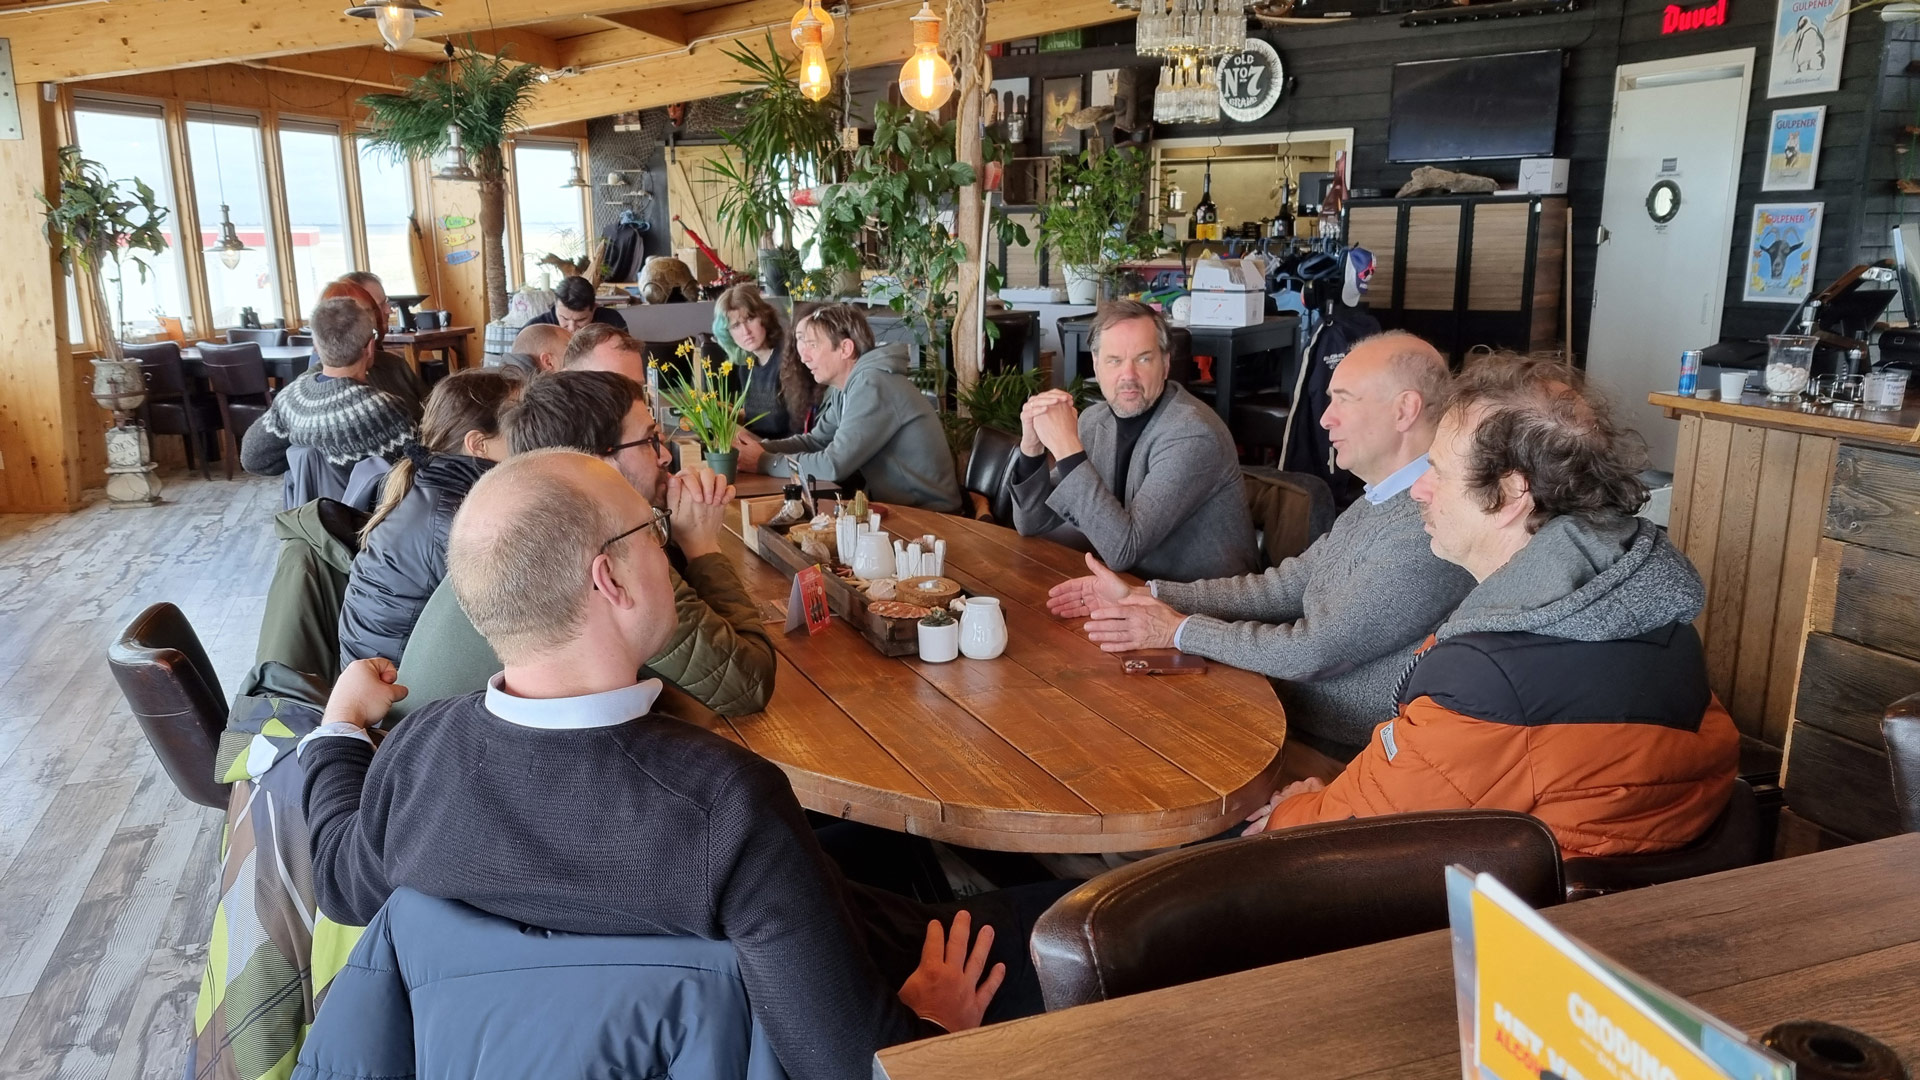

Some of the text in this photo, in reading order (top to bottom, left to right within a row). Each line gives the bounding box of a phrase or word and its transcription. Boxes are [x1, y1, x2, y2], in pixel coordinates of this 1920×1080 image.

[1792, 0, 1833, 13] GULPENER
[1662, 0, 1727, 34] Duvel
[1234, 54, 1254, 66] OLD
[1776, 118, 1816, 130] GULPENER
[1765, 214, 1805, 224] GULPENER
[1494, 1001, 1544, 1057] HET
